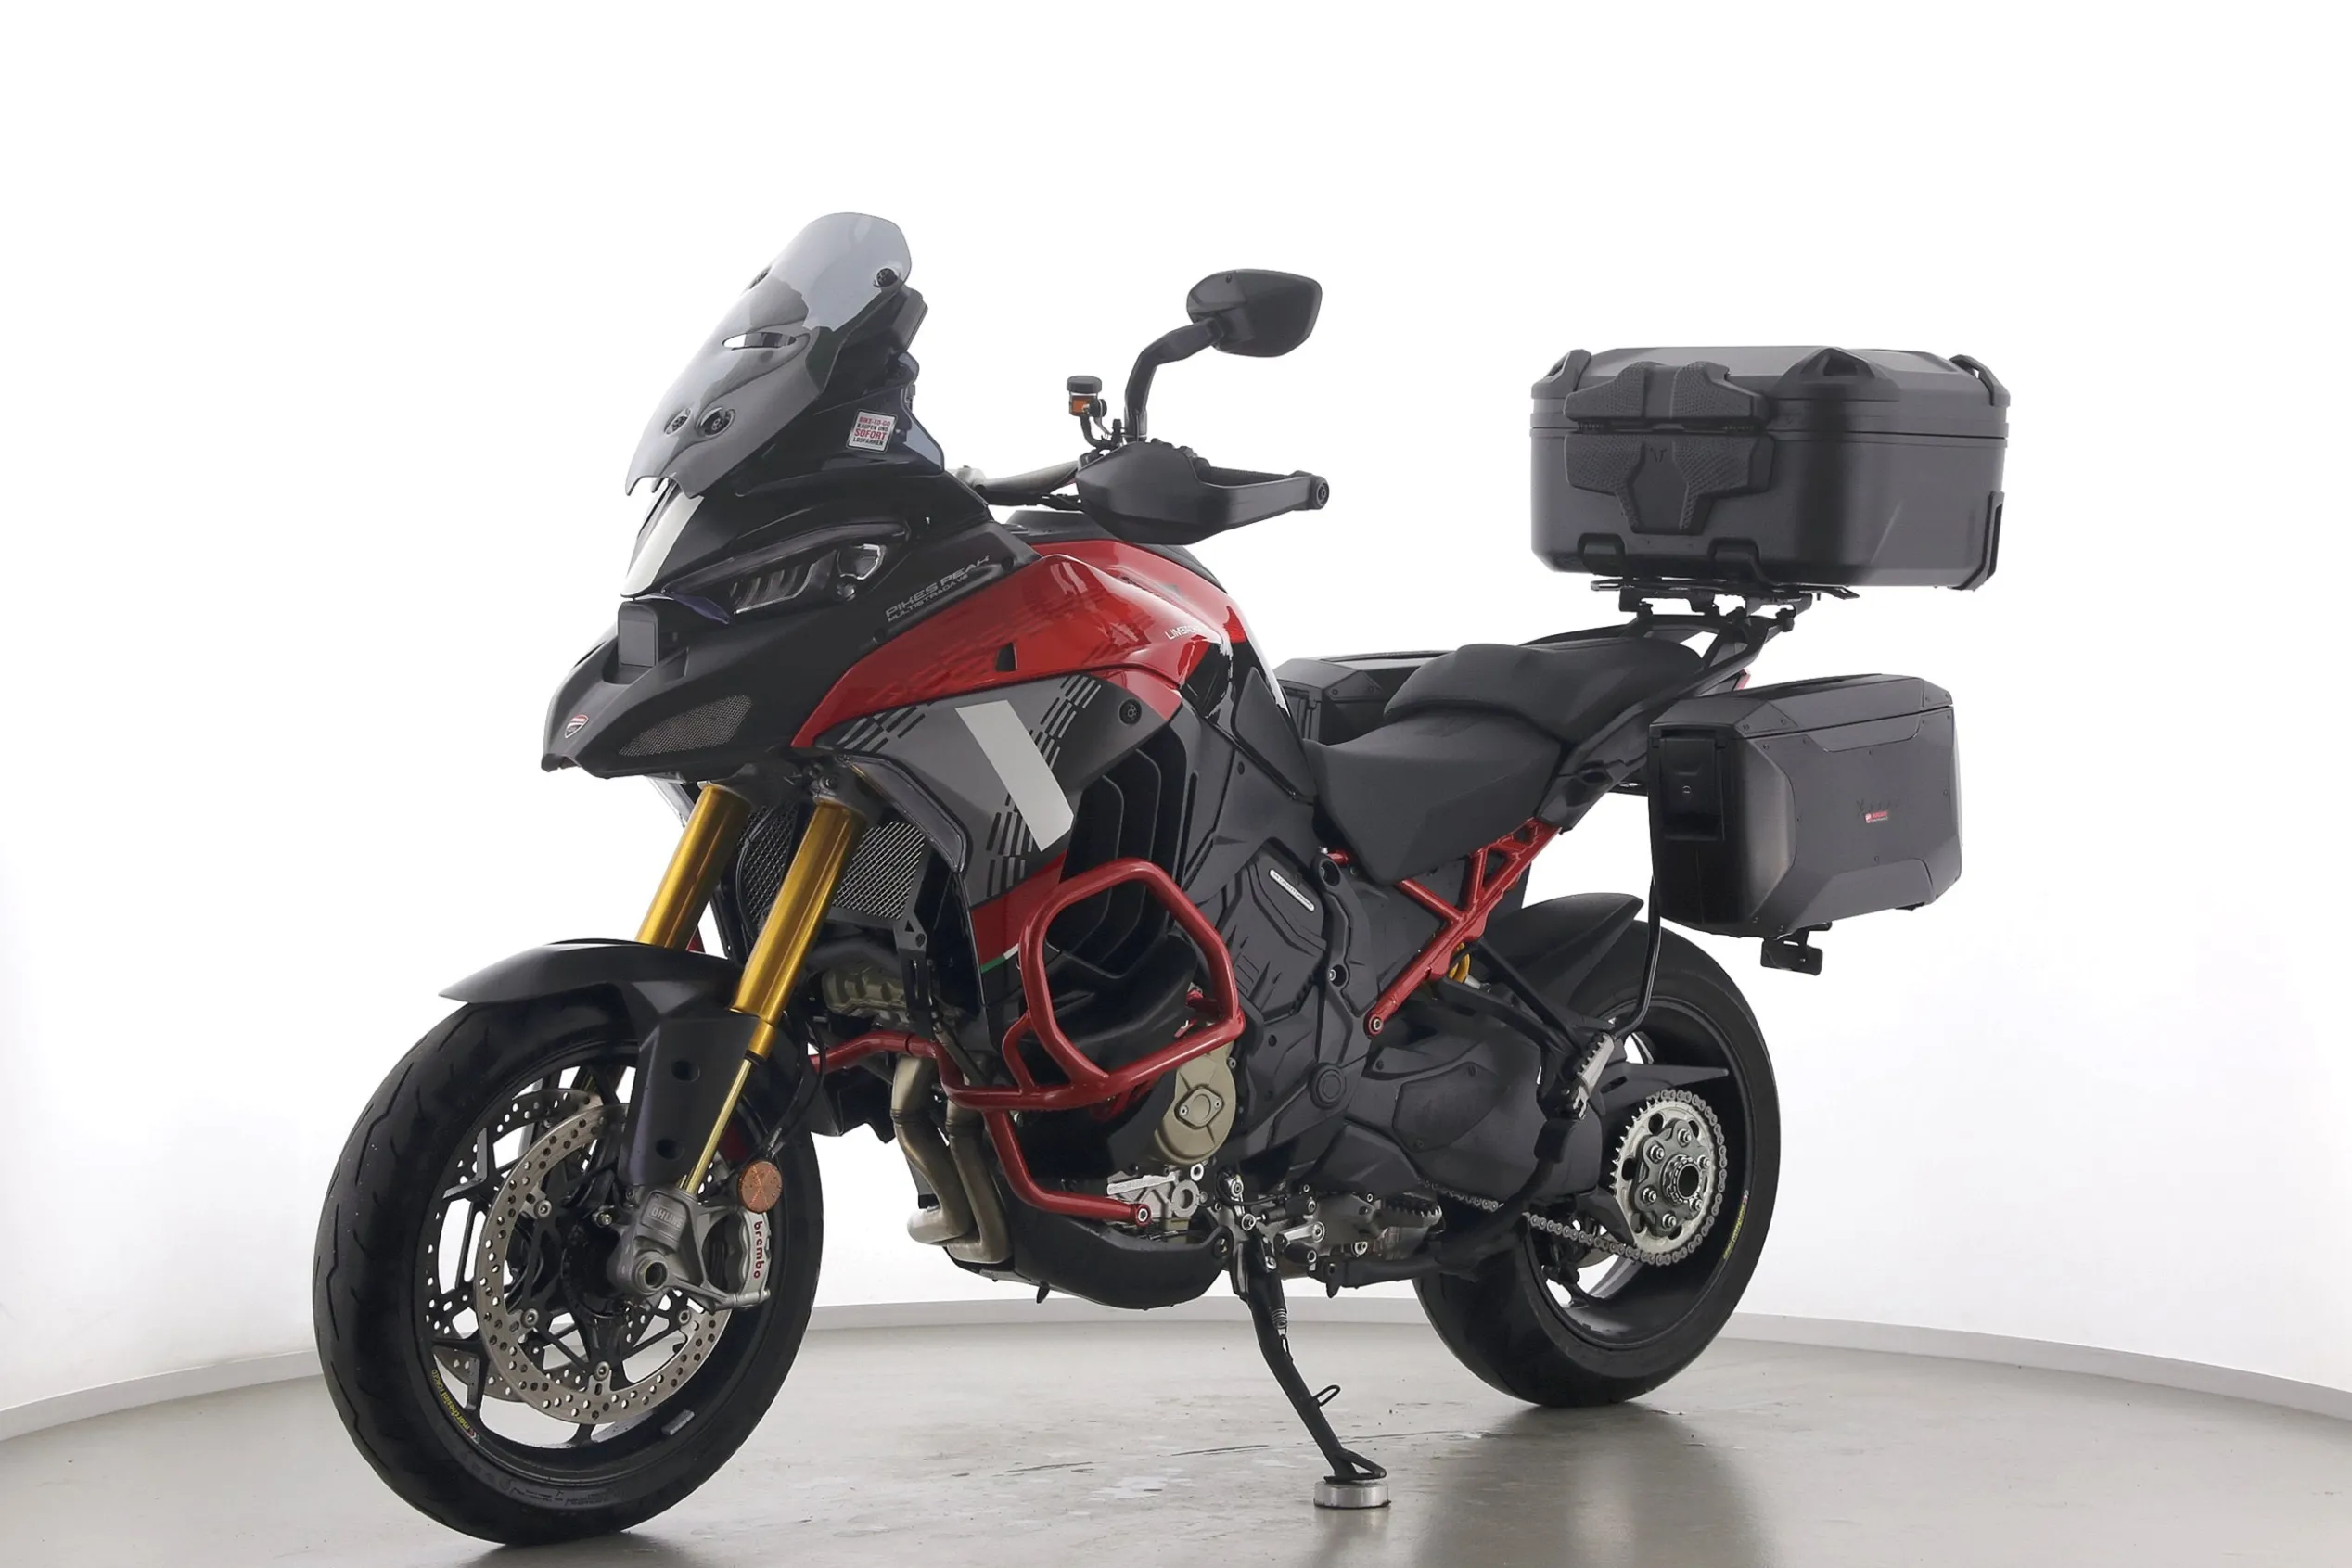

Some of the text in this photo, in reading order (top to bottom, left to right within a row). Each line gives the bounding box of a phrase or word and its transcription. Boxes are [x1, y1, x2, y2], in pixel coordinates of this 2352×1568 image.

[853, 437, 884, 445] LOSFAHREN
[854, 428, 887, 440] SOFORT
[857, 423, 877, 431] KAUFEN
[886, 555, 990, 618] PIKES PEAK
[888, 581, 956, 622] MULTISTRADA
[753, 1220, 765, 1280] brembo
[441, 1392, 470, 1430] marchesini
